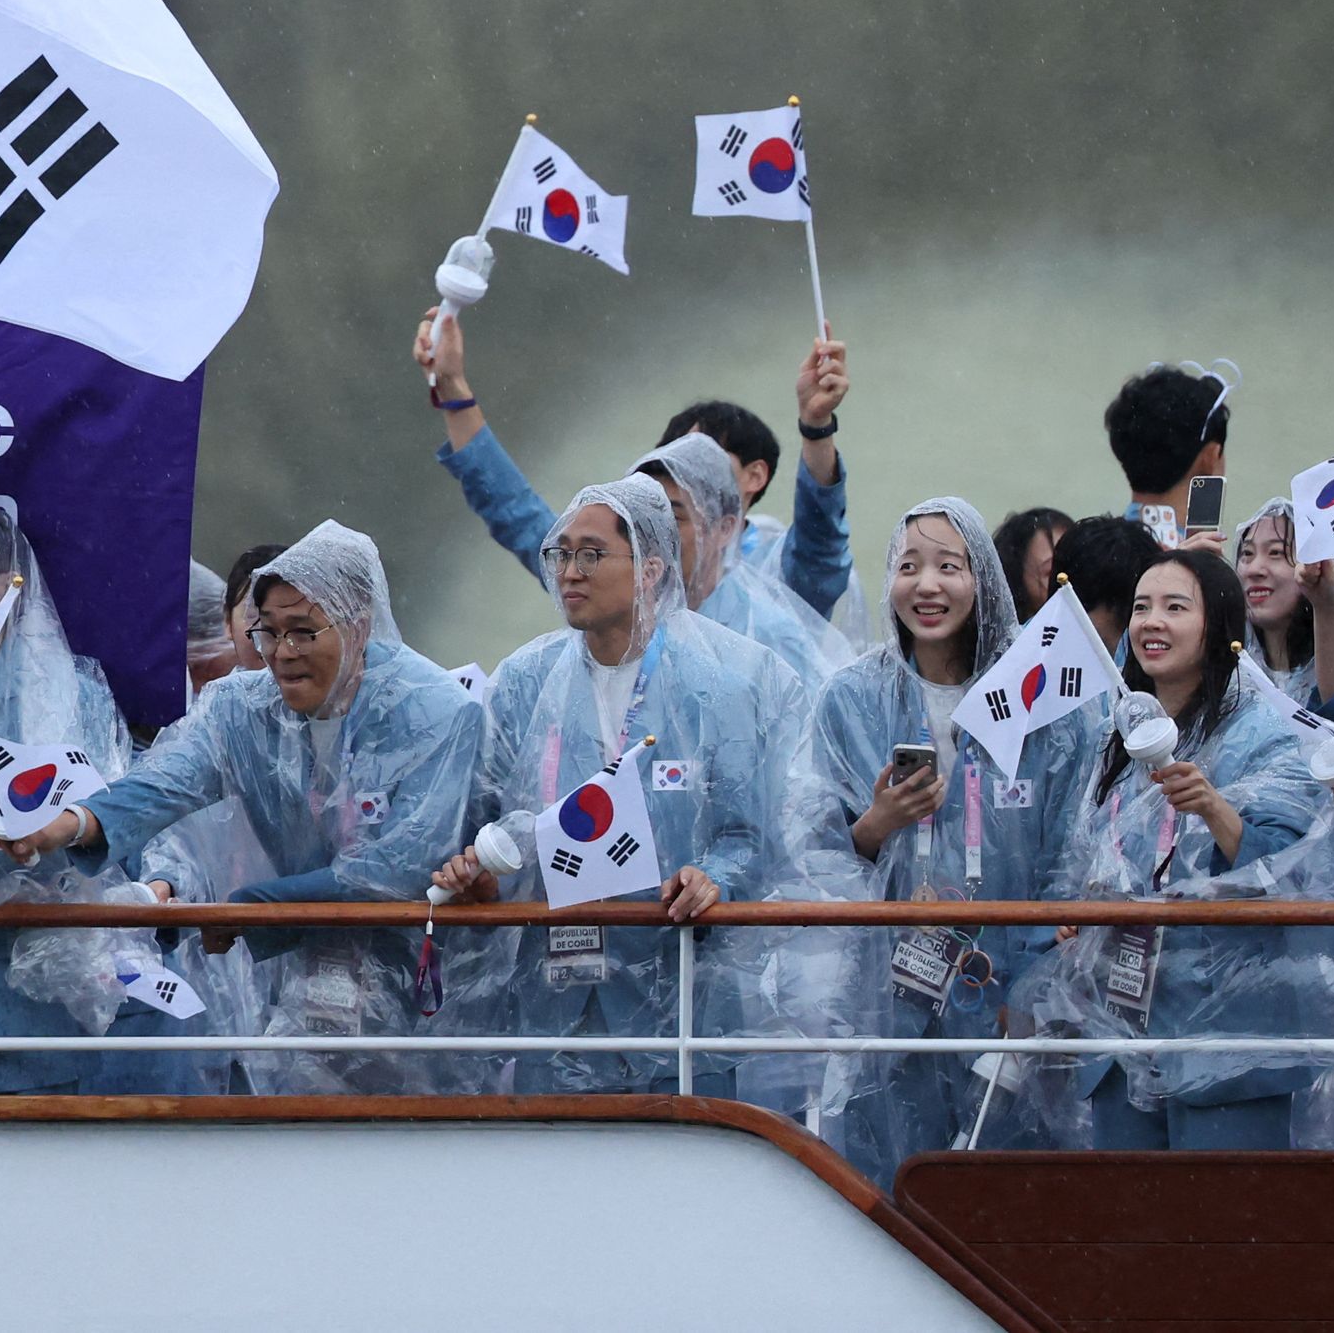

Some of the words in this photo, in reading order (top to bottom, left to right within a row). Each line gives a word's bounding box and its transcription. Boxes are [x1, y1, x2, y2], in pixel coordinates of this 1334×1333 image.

[556, 940, 566, 949] DE
[898, 957, 909, 969] DE
[1120, 952, 1141, 967] KOR
